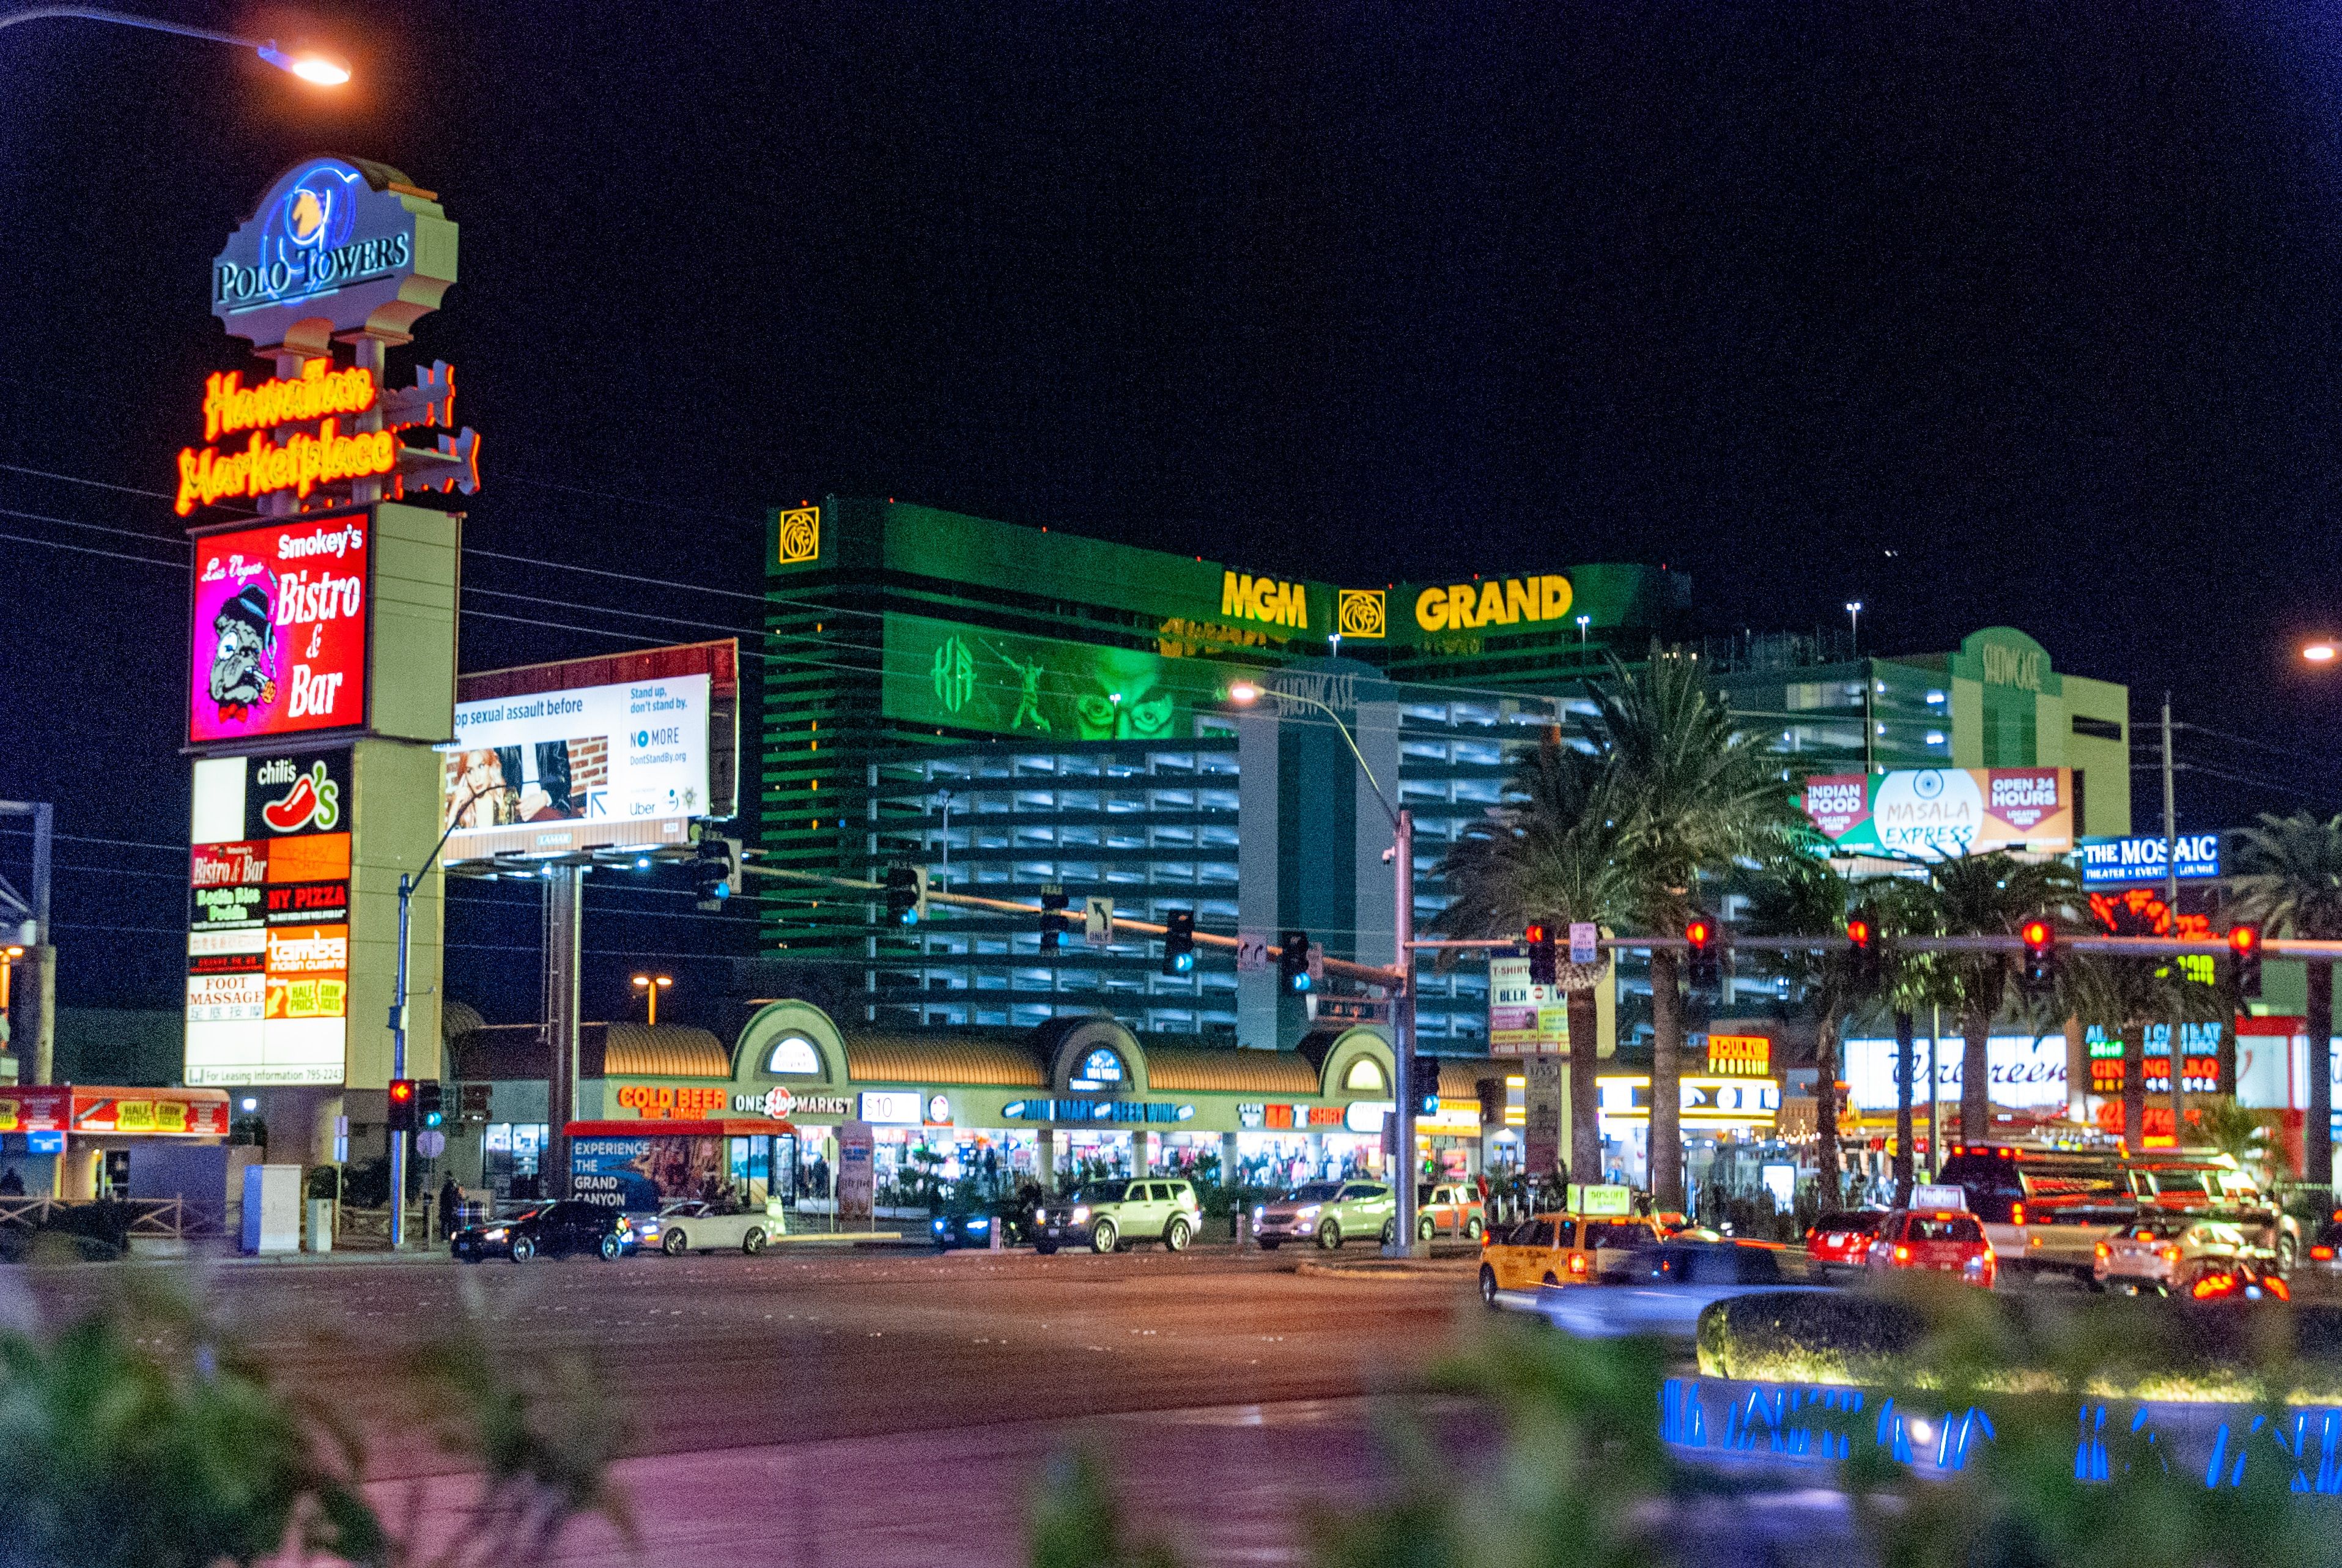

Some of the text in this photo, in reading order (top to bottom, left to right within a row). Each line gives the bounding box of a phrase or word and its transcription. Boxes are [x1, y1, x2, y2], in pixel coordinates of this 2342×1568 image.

[216, 232, 410, 304] POLO TOWERS
[202, 357, 376, 443] Hawaiian
[175, 416, 397, 517] Marketplace
[278, 523, 363, 560] Smokey's
[275, 570, 361, 626] Bistro
[1222, 570, 1307, 629] MGM
[1415, 574, 1573, 632] GRAND
[288, 664, 343, 718] Bar
[630, 686, 667, 700] Stand up,
[470, 704, 504, 724] sexual
[506, 700, 544, 721] assault
[547, 697, 583, 716] before
[630, 697, 687, 714] don't stand by.
[651, 728, 679, 746] MORE
[630, 752, 687, 766] DontStandBy.org
[257, 758, 297, 785] chili's
[1807, 784, 1861, 799] INDIAN
[1992, 777, 2055, 792] OPEN 24
[1808, 797, 1861, 814] FOOD
[1992, 790, 2056, 807] HOURS
[630, 802, 656, 816] Uber
[1887, 800, 1970, 823] MASALA
[1885, 824, 1973, 845] EXPRESS
[2084, 845, 2118, 864] THE
[193, 858, 230, 884] Bistro
[243, 856, 267, 882] Bar
[268, 885, 346, 909] NY PIZZA
[268, 930, 347, 962] tamba
[270, 961, 305, 971] indian
[305, 958, 346, 971] cuisine
[205, 978, 248, 990] FOOT
[292, 986, 313, 998] HALF
[190, 991, 265, 1005] MASSAGE
[290, 999, 316, 1011] PRICE
[206, 1069, 219, 1081] For
[221, 1069, 251, 1084] Leasing
[254, 1068, 304, 1081] Information
[619, 1085, 728, 1111] COLD BEER
[735, 1095, 765, 1112] ONE
[796, 1095, 854, 1114] MARKET
[1309, 1107, 1346, 1125] SHIRT
[575, 1142, 650, 1155] EXPERIENCE
[575, 1159, 598, 1172] THE
[574, 1176, 618, 1189] GRAND
